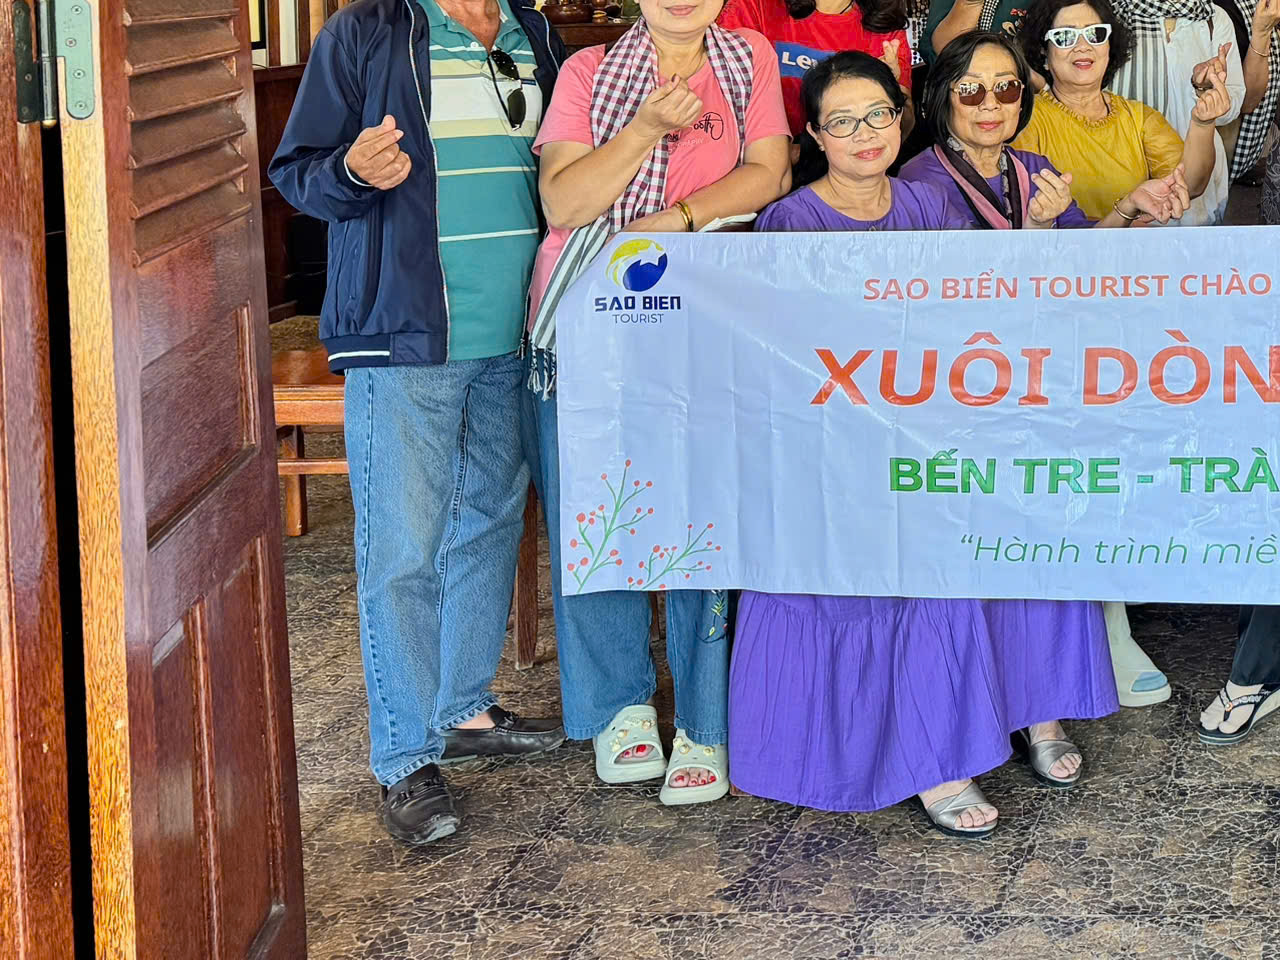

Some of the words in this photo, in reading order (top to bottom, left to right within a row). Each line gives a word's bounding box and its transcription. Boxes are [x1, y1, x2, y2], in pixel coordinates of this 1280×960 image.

[864, 277, 929, 300] SAO
[941, 268, 1018, 299] BIỂN
[1029, 274, 1169, 298] TOURIST
[1179, 268, 1272, 296] CHÀO
[594, 296, 635, 312] SAO
[643, 296, 681, 310] BIEN
[612, 314, 664, 324] TOURIST
[811, 331, 1051, 406] XUÔI
[889, 448, 997, 494] BẾN
[1013, 457, 1120, 494] TRE
[1136, 474, 1154, 484] -
[1169, 447, 1280, 493] TRÀ
[1095, 537, 1188, 564] trình
